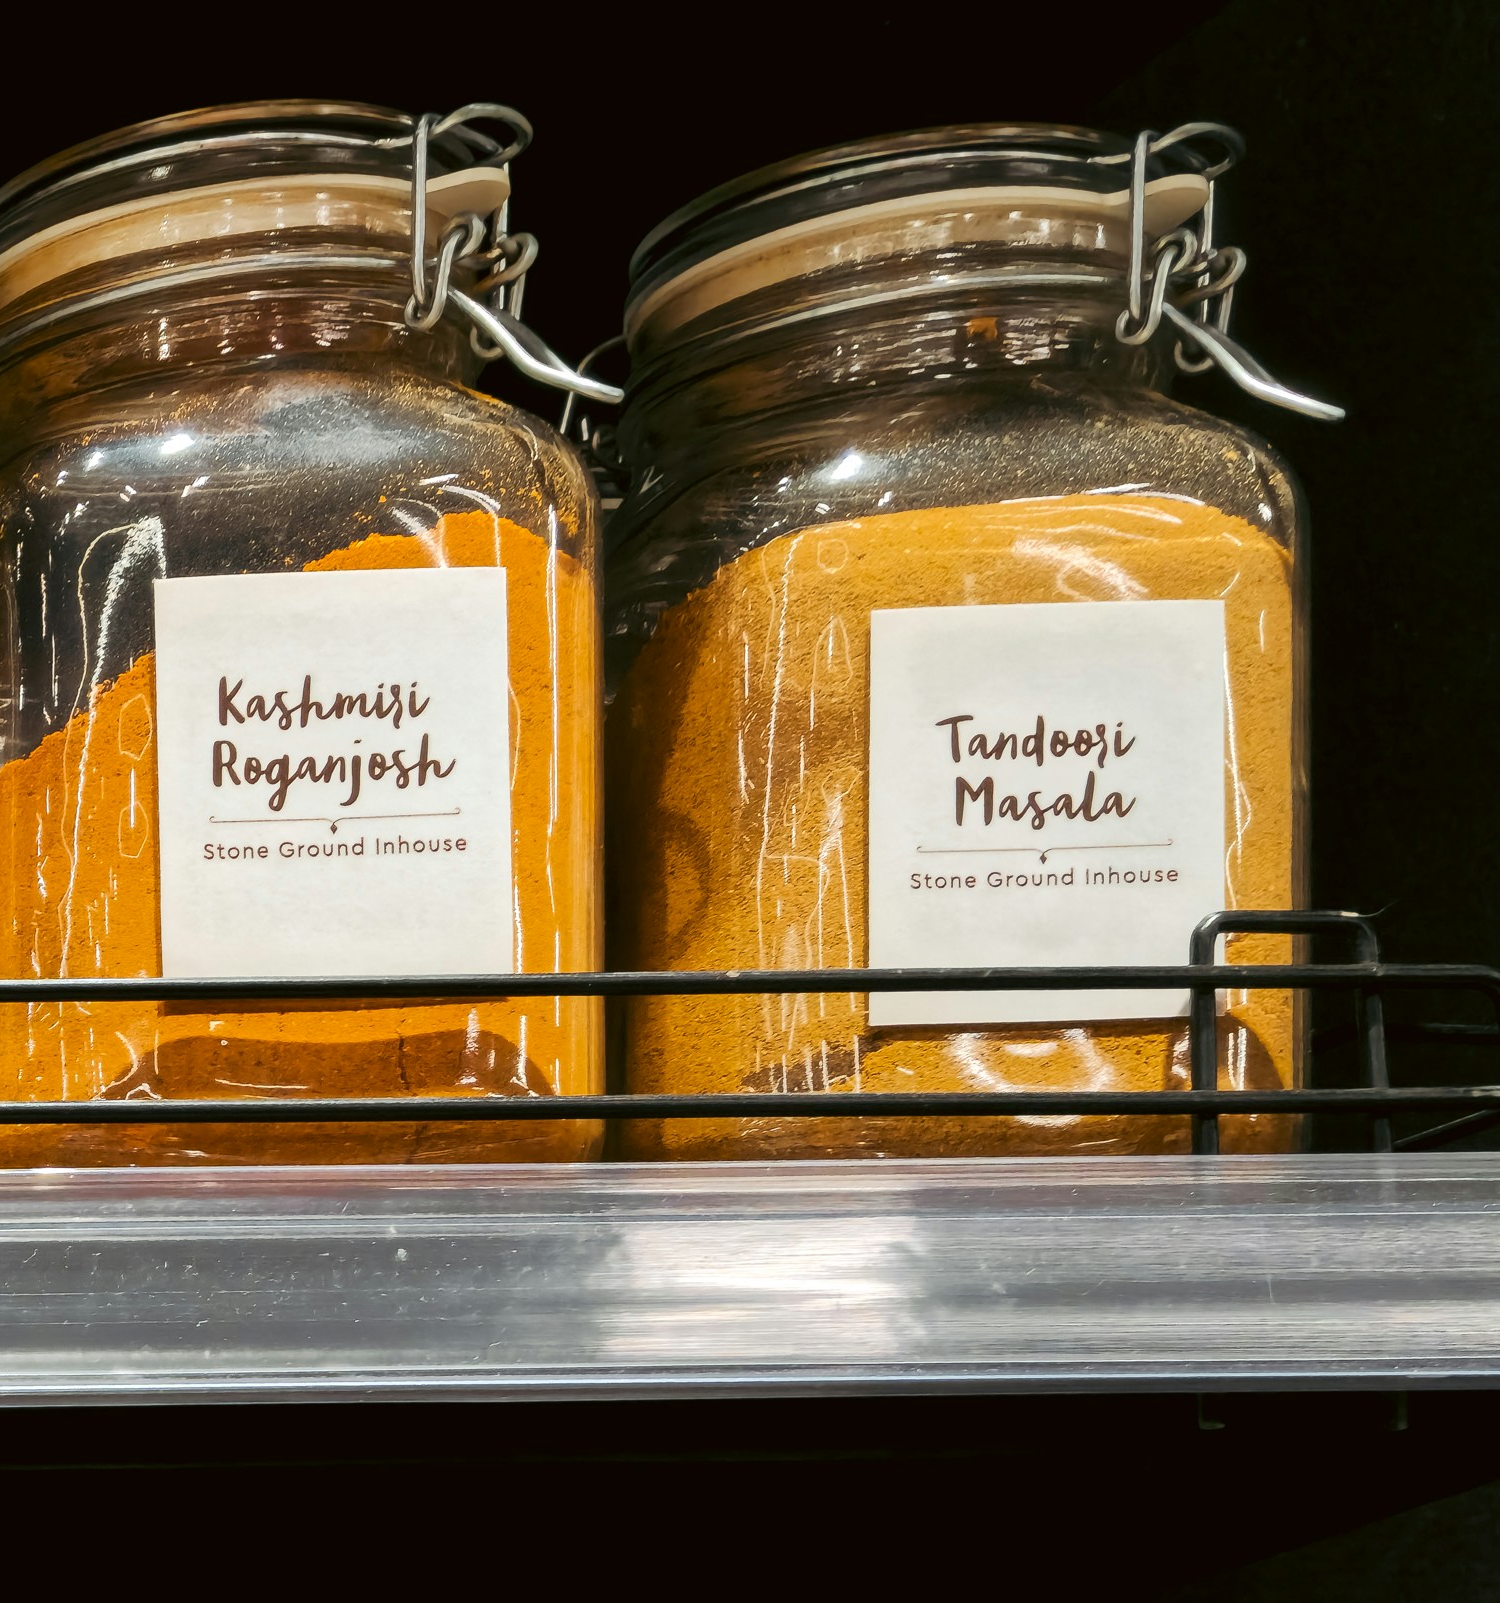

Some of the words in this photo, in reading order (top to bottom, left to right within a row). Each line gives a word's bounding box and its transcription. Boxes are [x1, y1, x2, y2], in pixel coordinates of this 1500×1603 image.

[219, 675, 430, 730] Kashmiri
[935, 715, 1136, 769] Tandoori
[213, 733, 456, 811] Roganjosh
[956, 771, 1136, 830] Masala
[204, 844, 269, 861] Stone
[278, 838, 364, 859] Ground
[375, 835, 468, 855] Inhouse
[910, 873, 976, 890] Stone
[987, 867, 1075, 888] Ground
[1086, 865, 1178, 885] Inhouse
